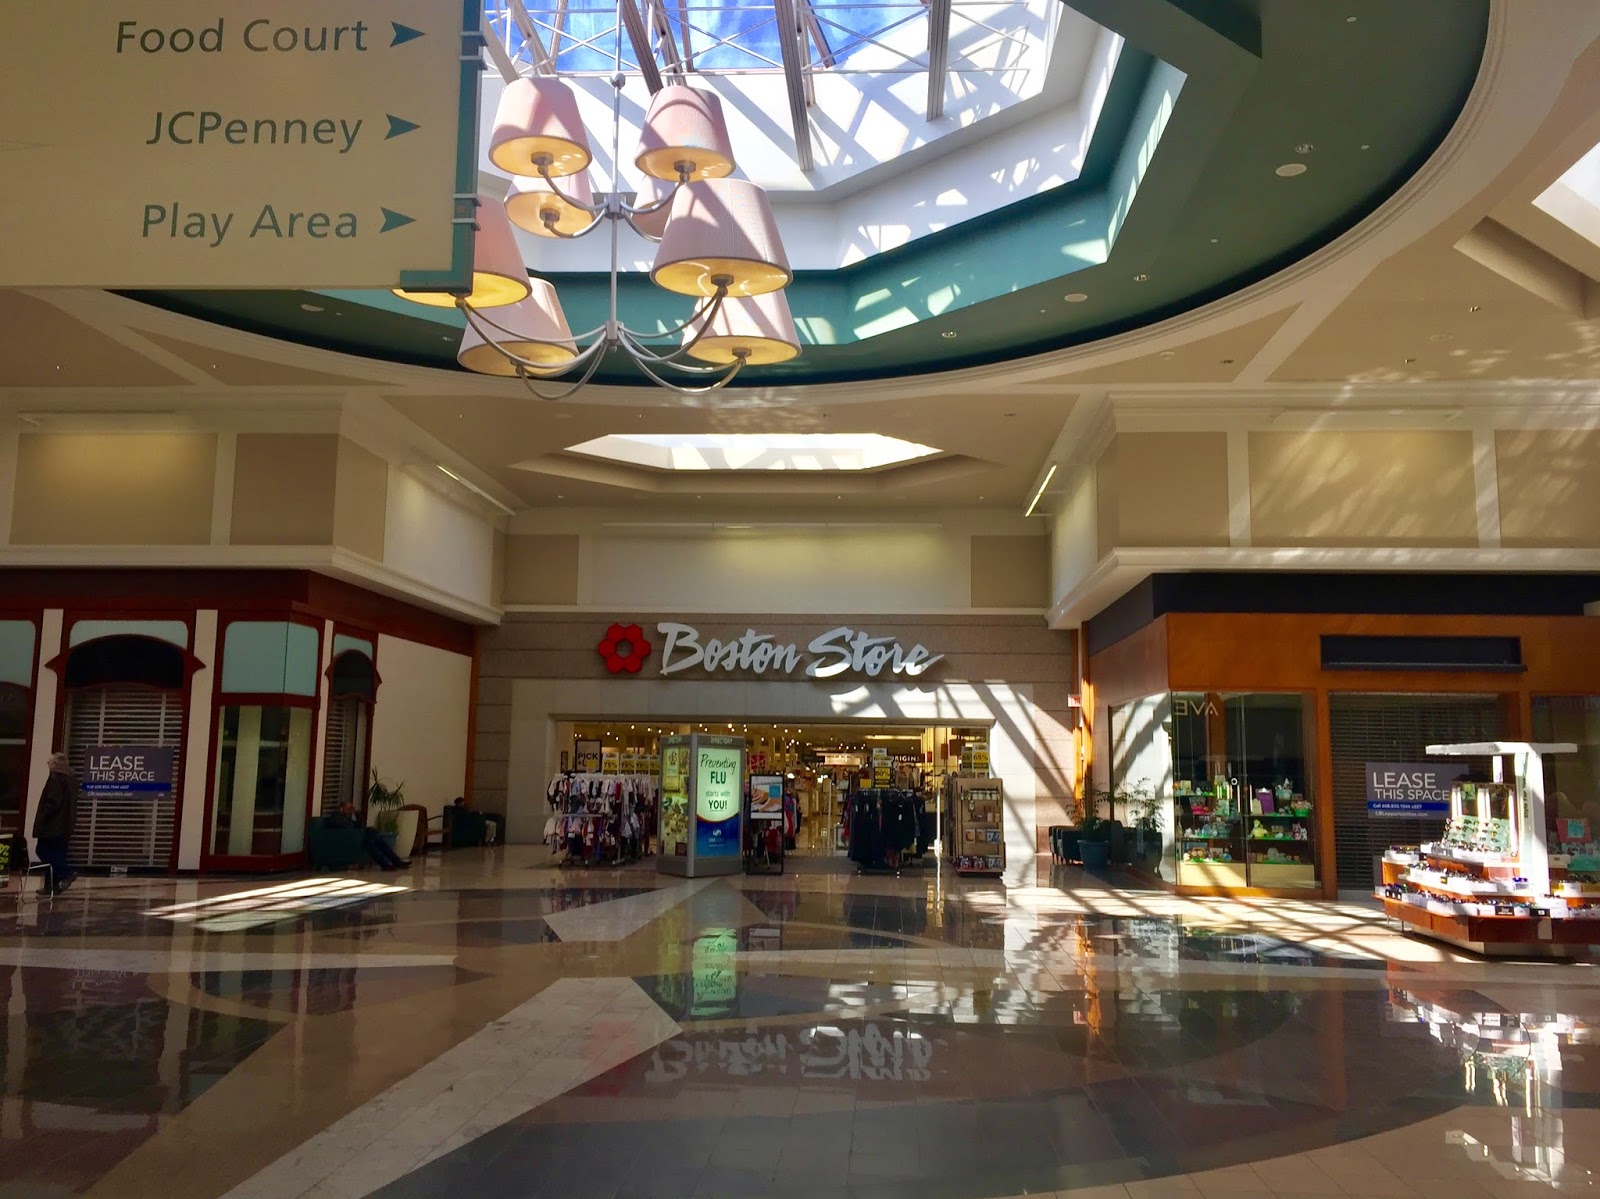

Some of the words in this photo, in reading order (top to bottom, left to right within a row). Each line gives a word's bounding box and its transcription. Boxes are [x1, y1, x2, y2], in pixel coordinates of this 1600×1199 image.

[116, 17, 224, 54] Food
[243, 18, 369, 53] Court
[146, 111, 363, 153] JCPenney
[142, 202, 234, 248] Play
[249, 204, 358, 239] Area
[657, 622, 803, 675] Boston
[805, 626, 945, 678] Store
[90, 755, 145, 771] LEASE
[700, 753, 737, 775] Preventing
[90, 771, 115, 781] THIS
[117, 771, 155, 782] SPACE
[710, 771, 727, 784] FLU
[1372, 772, 1437, 789] LEASE
[1374, 789, 1404, 800] THIS
[1408, 789, 1450, 801] SPACE
[708, 799, 728, 810] YOU!
